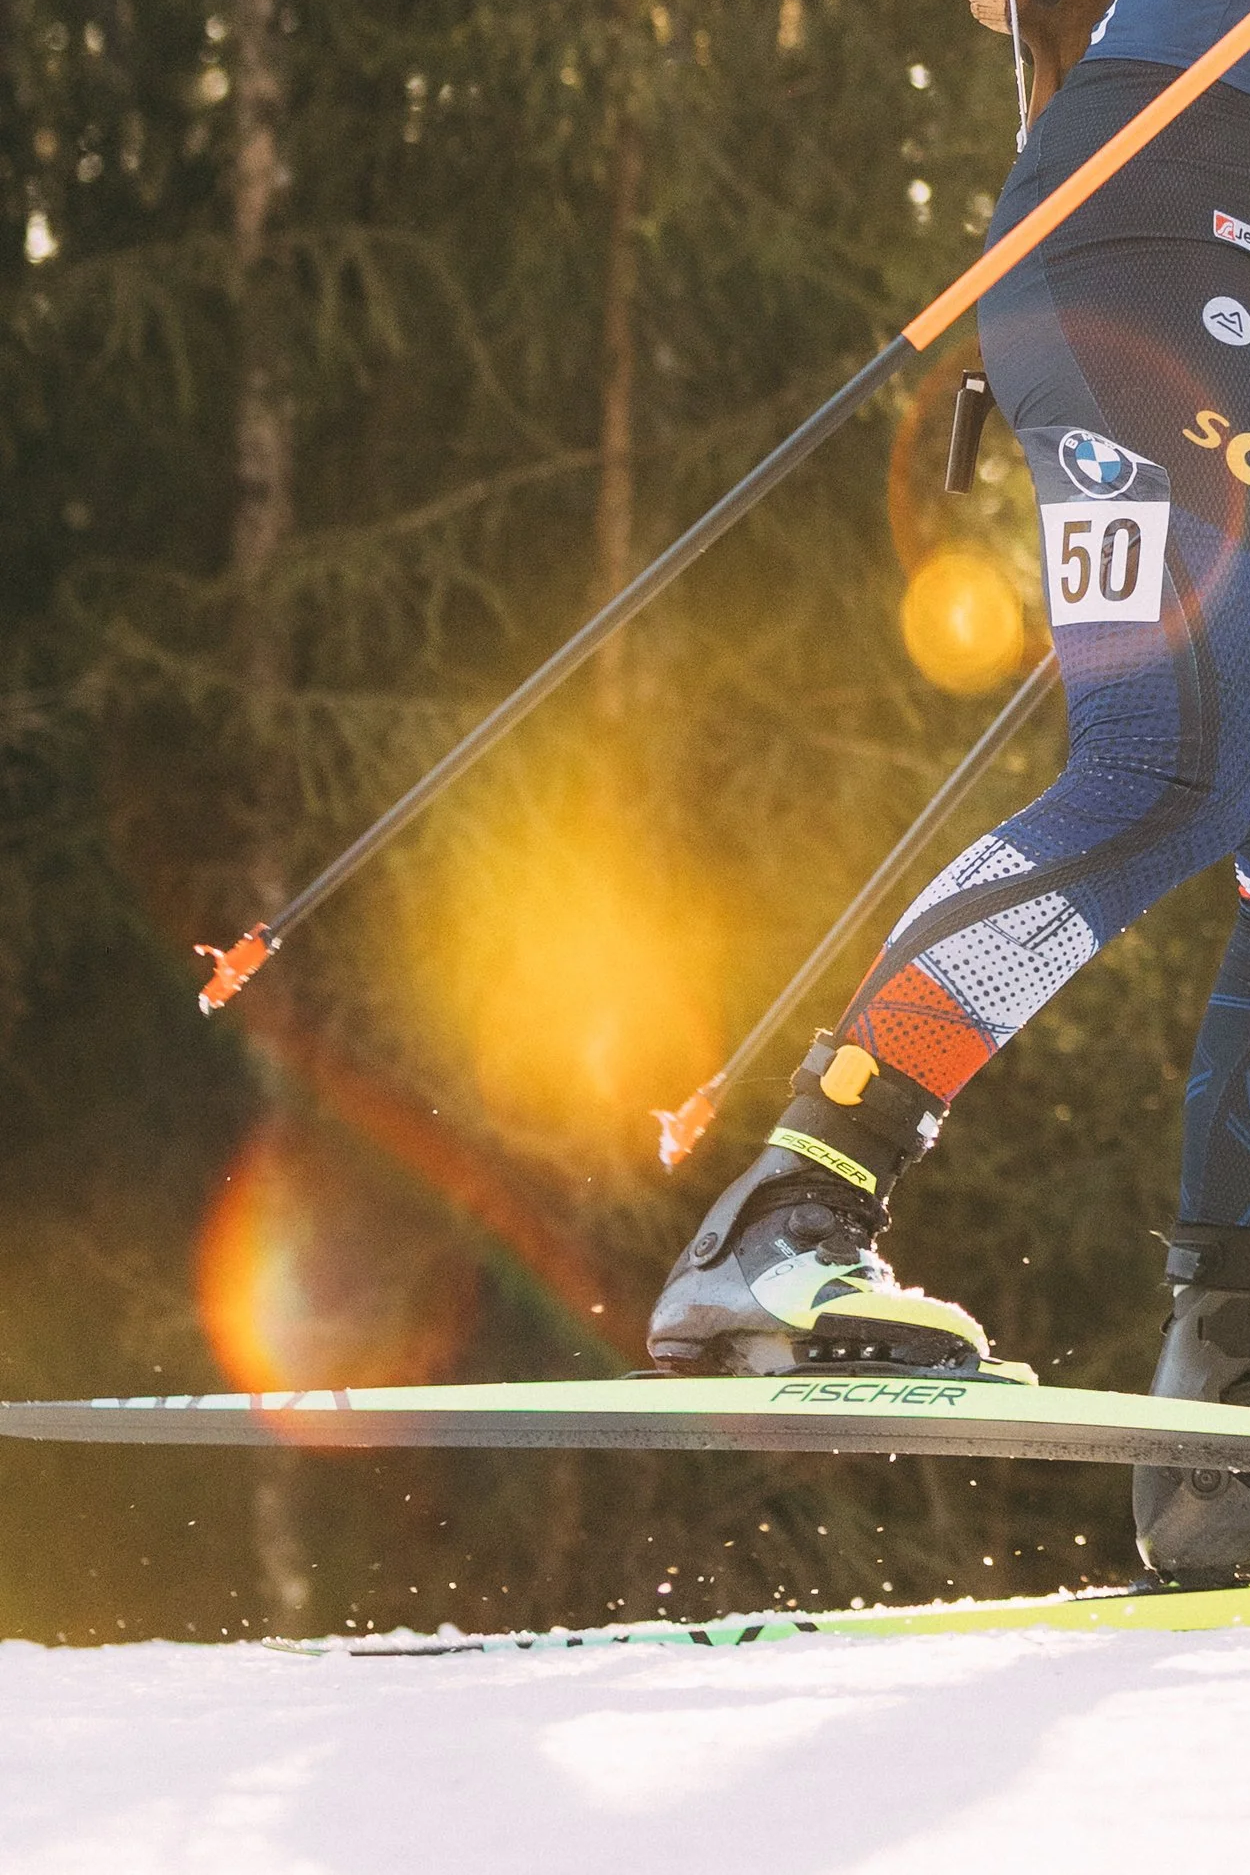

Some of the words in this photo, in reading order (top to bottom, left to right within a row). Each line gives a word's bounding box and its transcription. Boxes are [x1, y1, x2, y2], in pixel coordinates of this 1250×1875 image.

[1060, 517, 1142, 604] 50
[778, 1134, 868, 1185] FISCHER
[769, 1382, 967, 1407] FISCHER
